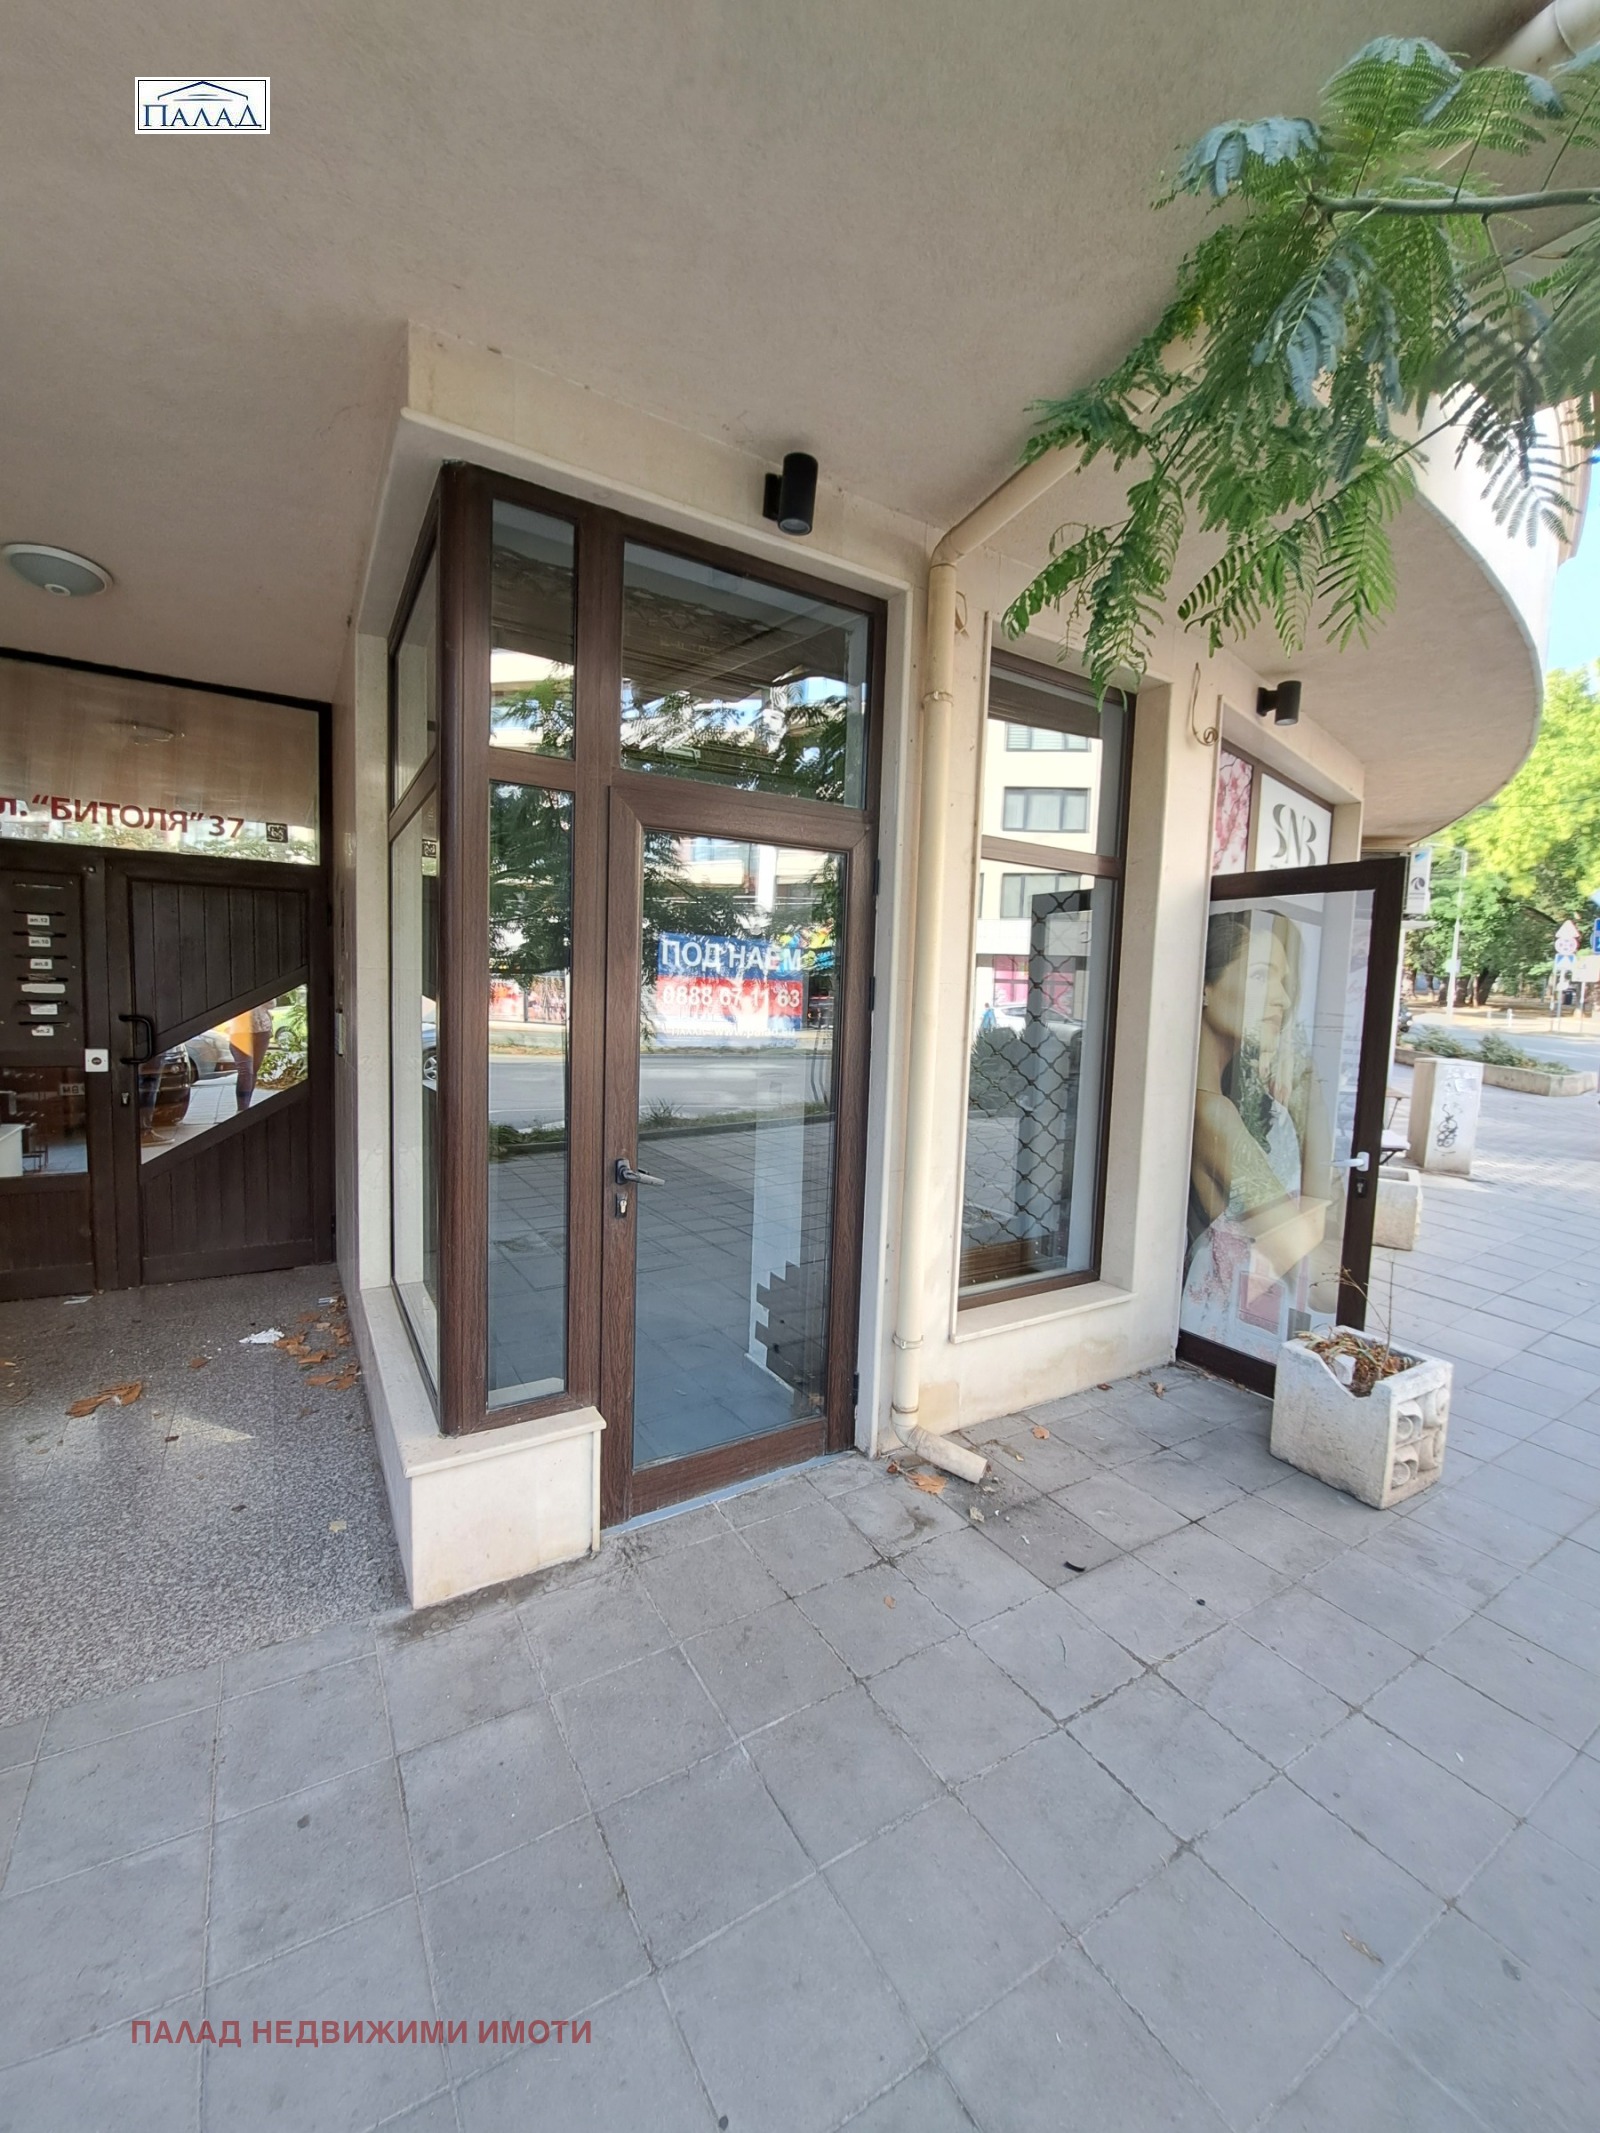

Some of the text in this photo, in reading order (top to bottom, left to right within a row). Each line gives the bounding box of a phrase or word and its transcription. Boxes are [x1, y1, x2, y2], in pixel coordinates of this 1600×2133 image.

[208, 815, 245, 838] 37
[661, 938, 801, 972] ПОД НАЕМ
[662, 984, 713, 1006] 0888
[777, 988, 800, 1008] 63
